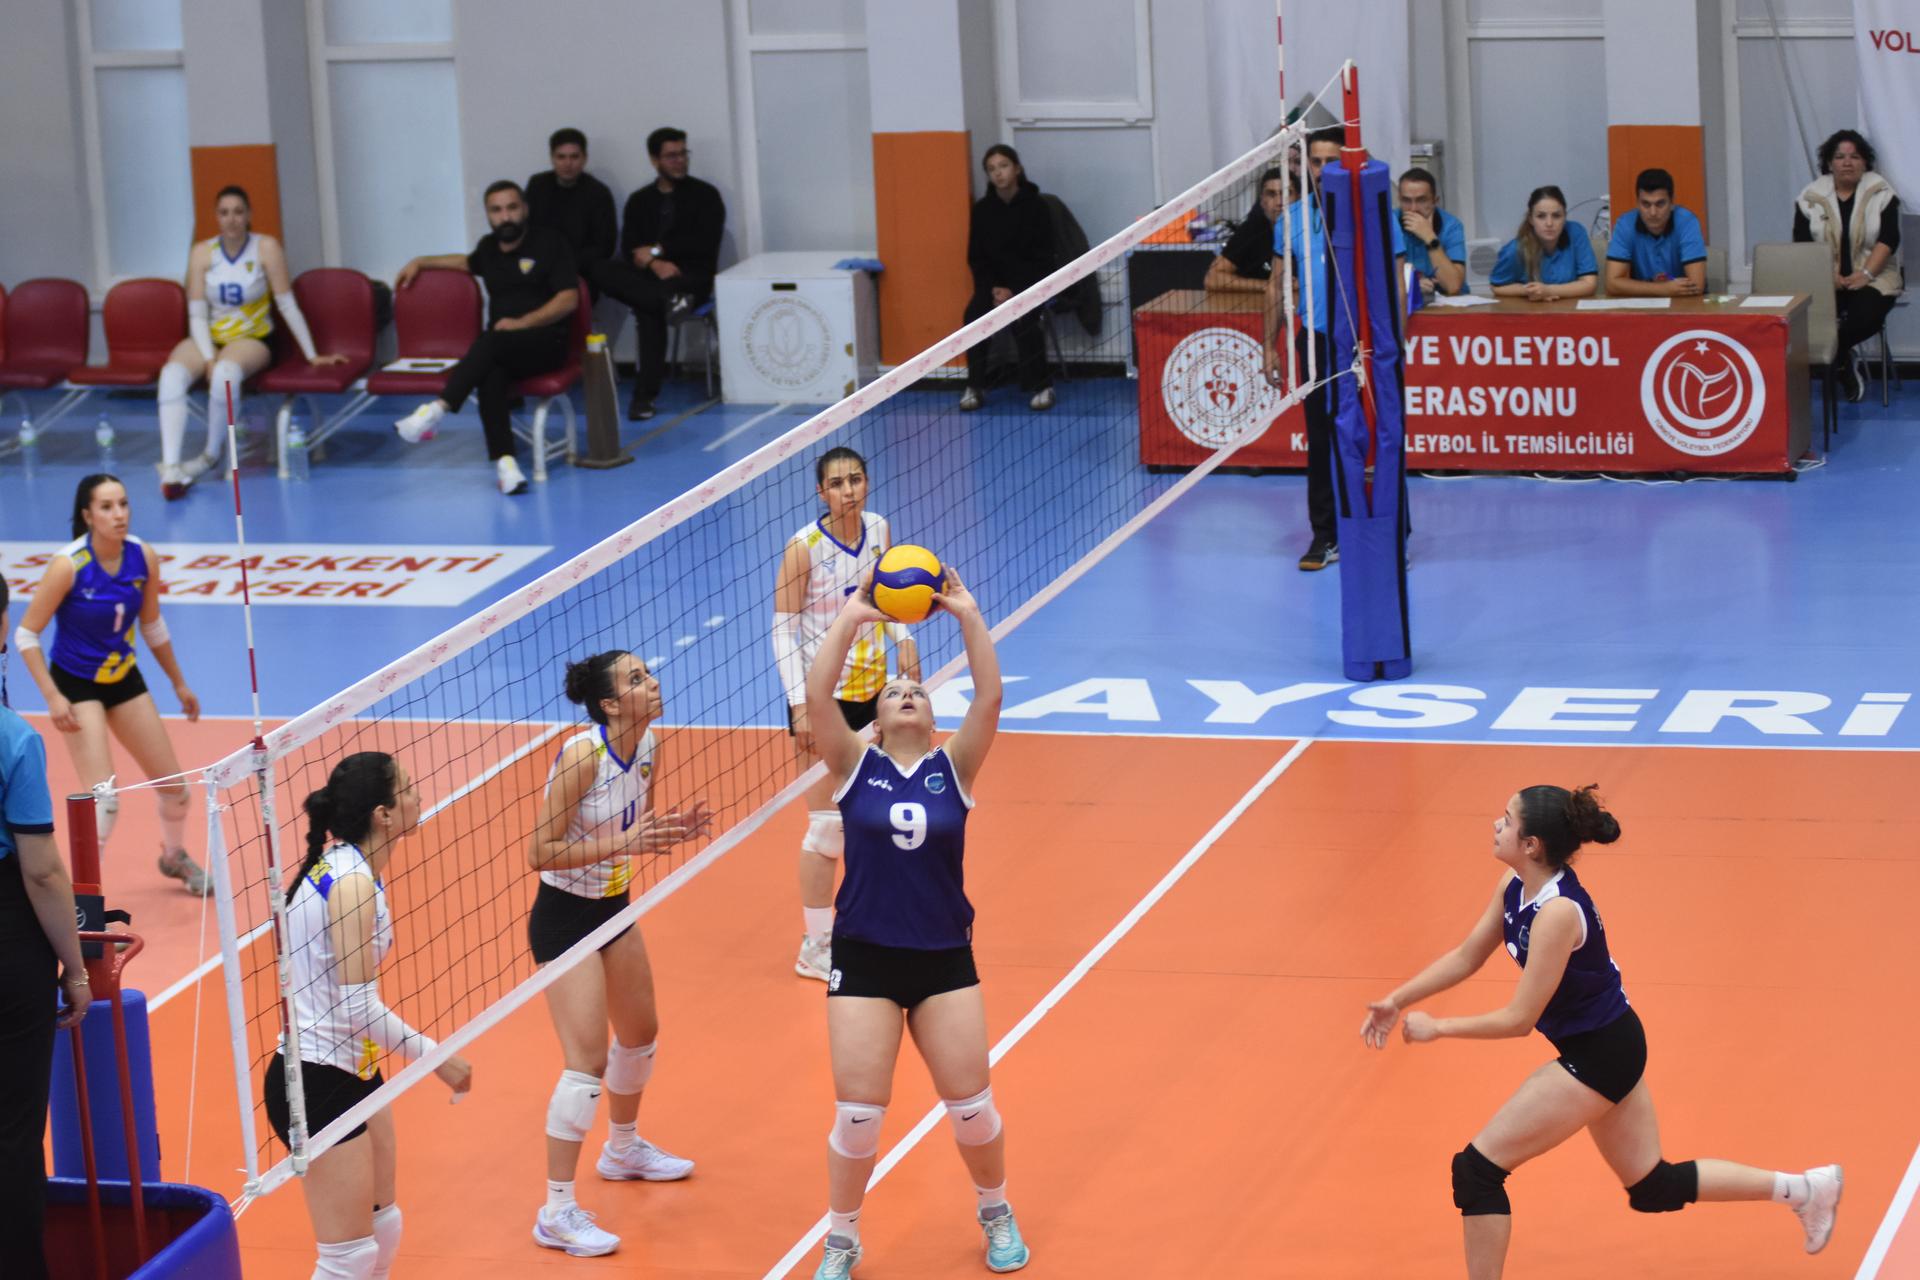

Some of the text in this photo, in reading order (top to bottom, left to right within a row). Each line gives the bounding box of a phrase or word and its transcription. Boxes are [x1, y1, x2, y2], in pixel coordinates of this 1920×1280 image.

[219, 283, 243, 306] 13
[1449, 335, 1620, 366] VOLEYBOL
[1482, 431, 1500, 453] İL
[1505, 431, 1634, 455] TEMSİLCİLİĞİ
[182, 552, 504, 575] BAŞKENTİ
[114, 602, 125, 633] 1
[889, 801, 928, 851] 9
